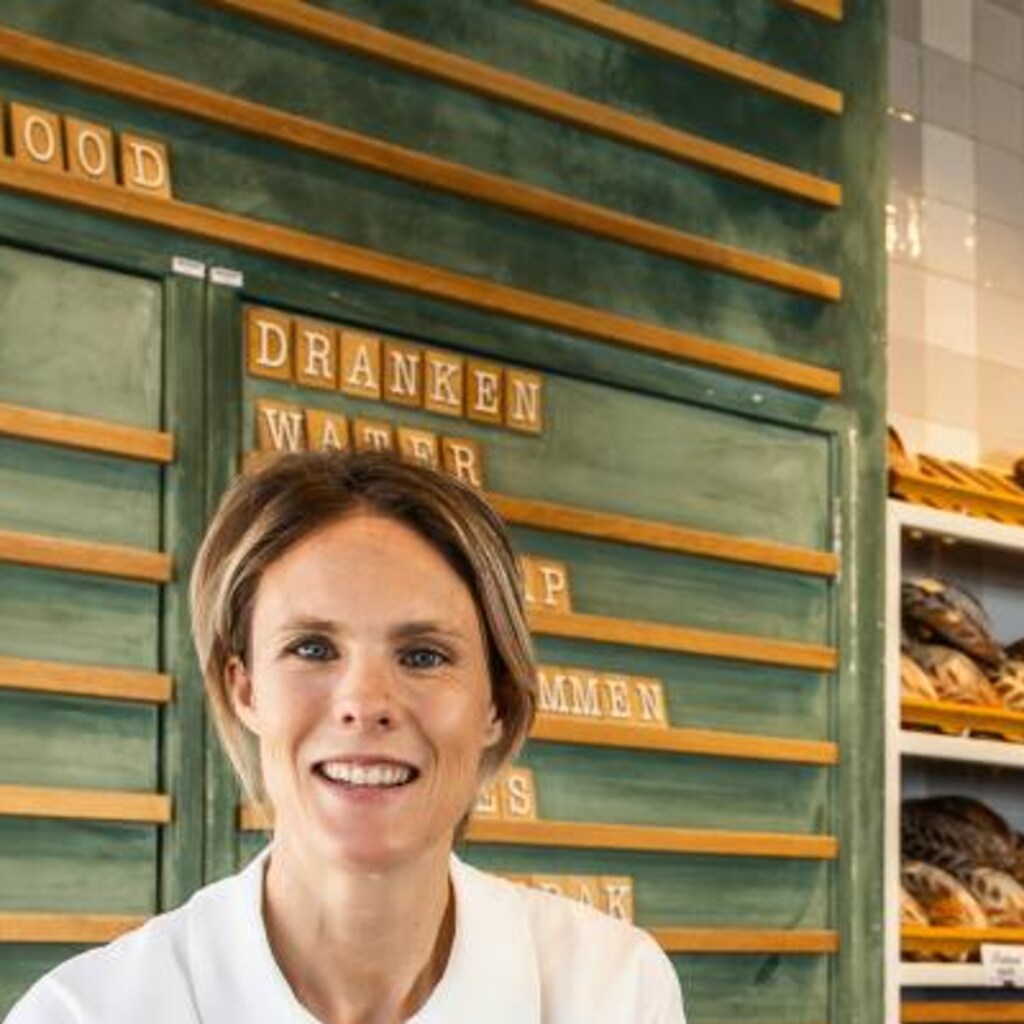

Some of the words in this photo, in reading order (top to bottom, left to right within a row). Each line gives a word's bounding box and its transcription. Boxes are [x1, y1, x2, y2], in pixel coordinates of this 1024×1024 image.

[255, 318, 541, 424] DRANKEN
[263, 408, 481, 488] WATER
[523, 566, 566, 606] P
